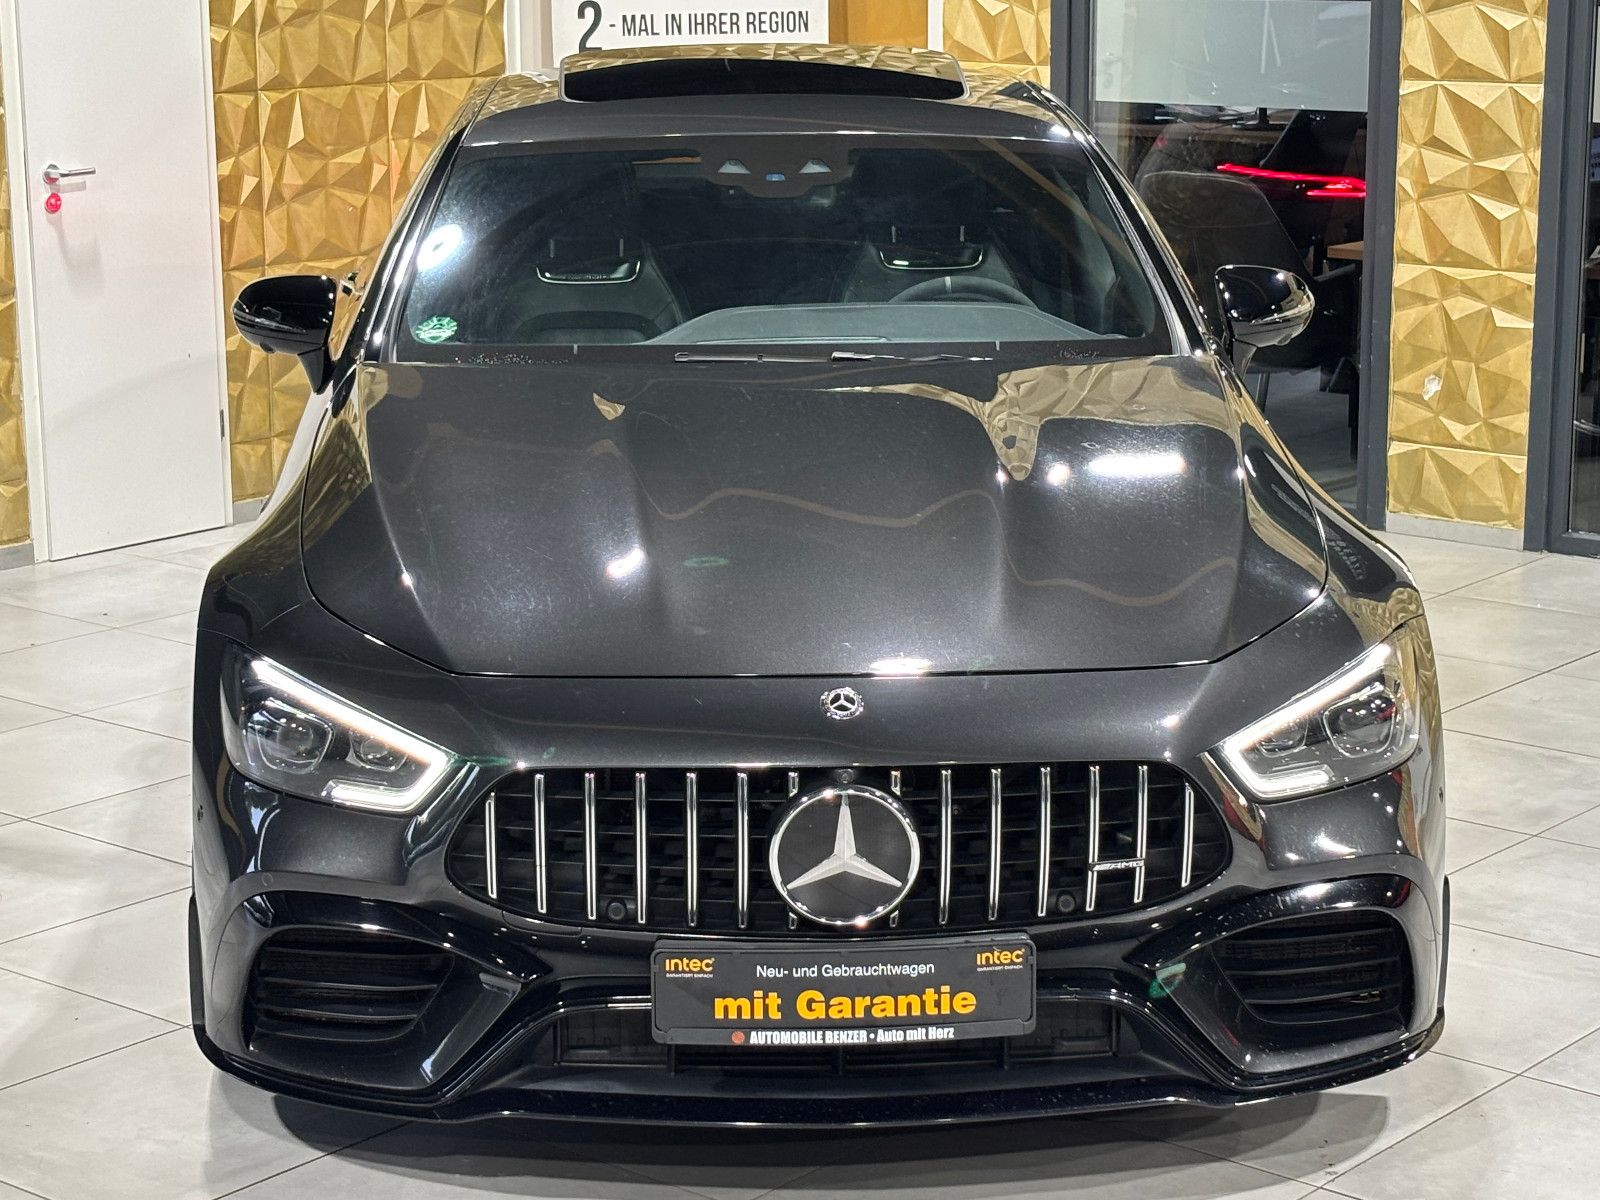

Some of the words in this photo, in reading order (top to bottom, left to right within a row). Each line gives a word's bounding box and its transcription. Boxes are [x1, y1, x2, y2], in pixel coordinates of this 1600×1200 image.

[577, 0, 602, 53] 2
[622, 14, 660, 36] MAL
[665, 13, 682, 35] IN
[688, 12, 740, 35] IHRER
[746, 11, 809, 33] REGION
[665, 957, 713, 972] intec
[976, 950, 1023, 966] intec
[756, 965, 788, 978] Neu-
[792, 964, 818, 978] und
[821, 963, 935, 978] Gebrauchtwagen
[714, 990, 782, 1020] mit
[796, 985, 976, 1020] Garantie
[750, 1031, 823, 1045] AUTOMOBILE
[825, 1030, 867, 1044] BENZER
[876, 1028, 904, 1042] Auto
[906, 1028, 926, 1041] mit
[928, 1026, 955, 1040] Herz
